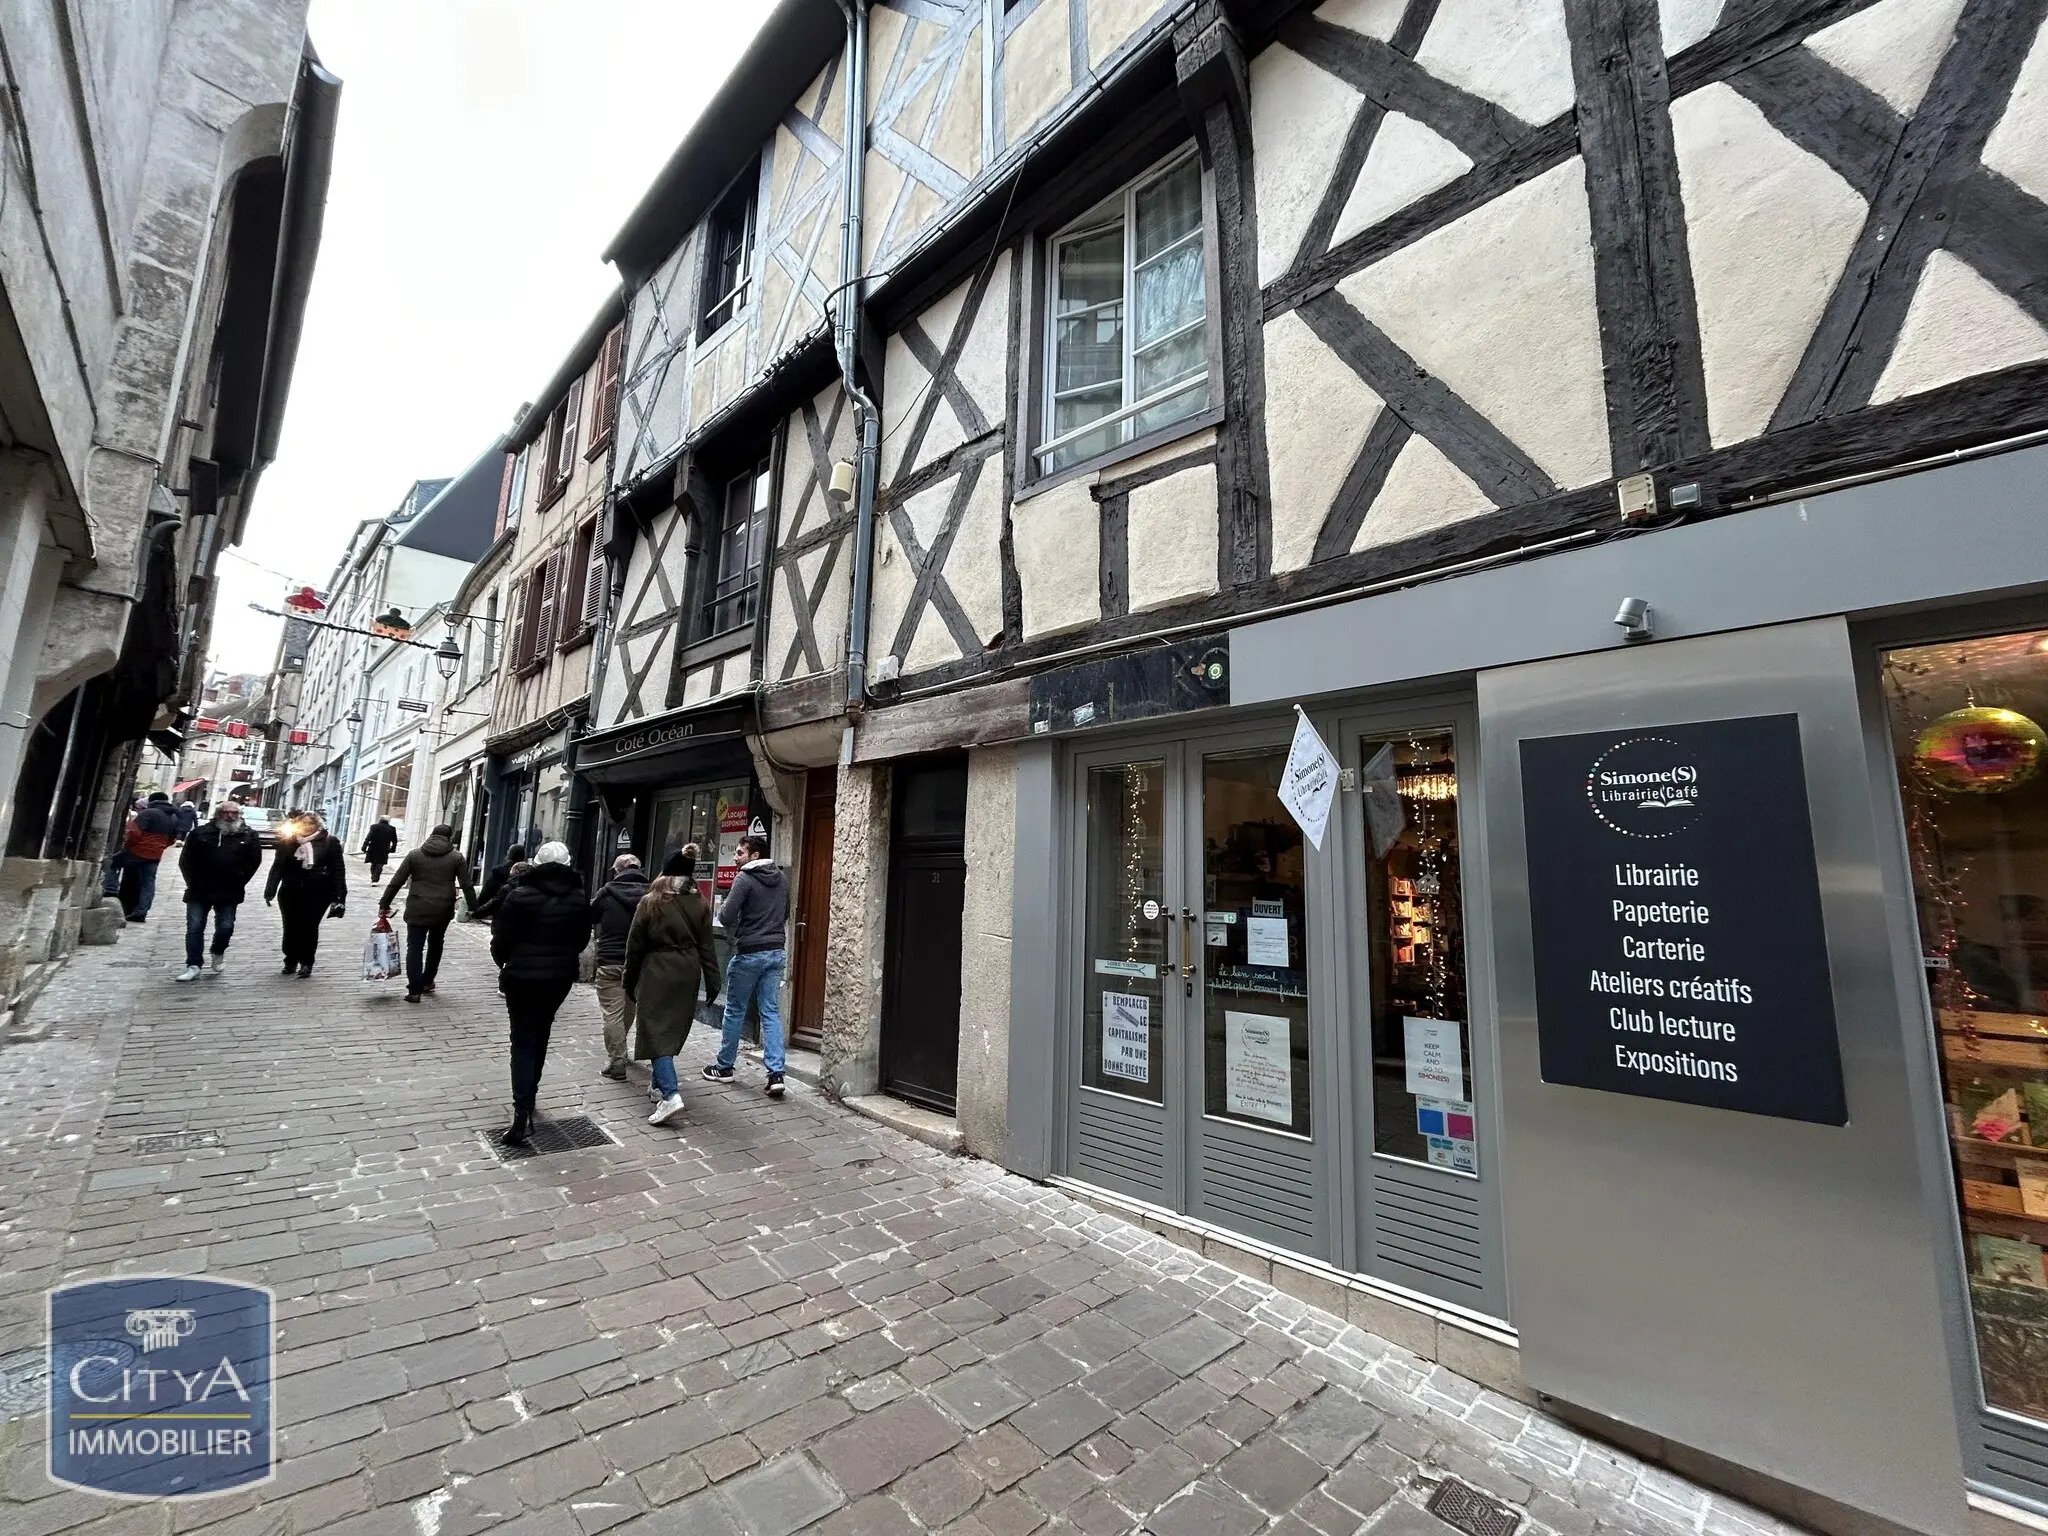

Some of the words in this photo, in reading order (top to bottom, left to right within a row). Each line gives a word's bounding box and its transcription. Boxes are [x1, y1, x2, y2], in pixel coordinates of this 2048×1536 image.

[615, 737, 644, 753] Coté
[648, 723, 694, 746] Océan
[1600, 766, 1697, 785] Simone(S)
[1602, 788, 1659, 802] Librairie
[1666, 785, 1698, 799] Café
[728, 810, 748, 819] LOCAUX
[1615, 863, 1699, 886] Librairie
[1254, 903, 1282, 914] OUVERT
[1612, 900, 1709, 927] Papeterie
[1622, 935, 1705, 962] Carterie
[1590, 969, 1665, 997] Ateliers
[1669, 976, 1753, 1004] créatifs
[1112, 995, 1148, 1010] REMPLACER
[1139, 1016, 1147, 1026] LE
[1610, 1007, 1654, 1033] Club
[1658, 1010, 1736, 1042] lecture
[1108, 1027, 1147, 1043] CAPITALISME
[1121, 1045, 1133, 1058] PAR
[1134, 1048, 1147, 1060] UNE
[1423, 1050, 1441, 1058] CALM
[1104, 1058, 1123, 1073] BONNE
[1125, 1063, 1147, 1077] SIESTE
[1615, 1044, 1738, 1082] Expositions
[1418, 1072, 1449, 1083] SIMONE(S)
[1455, 1157, 1471, 1165] VISA
